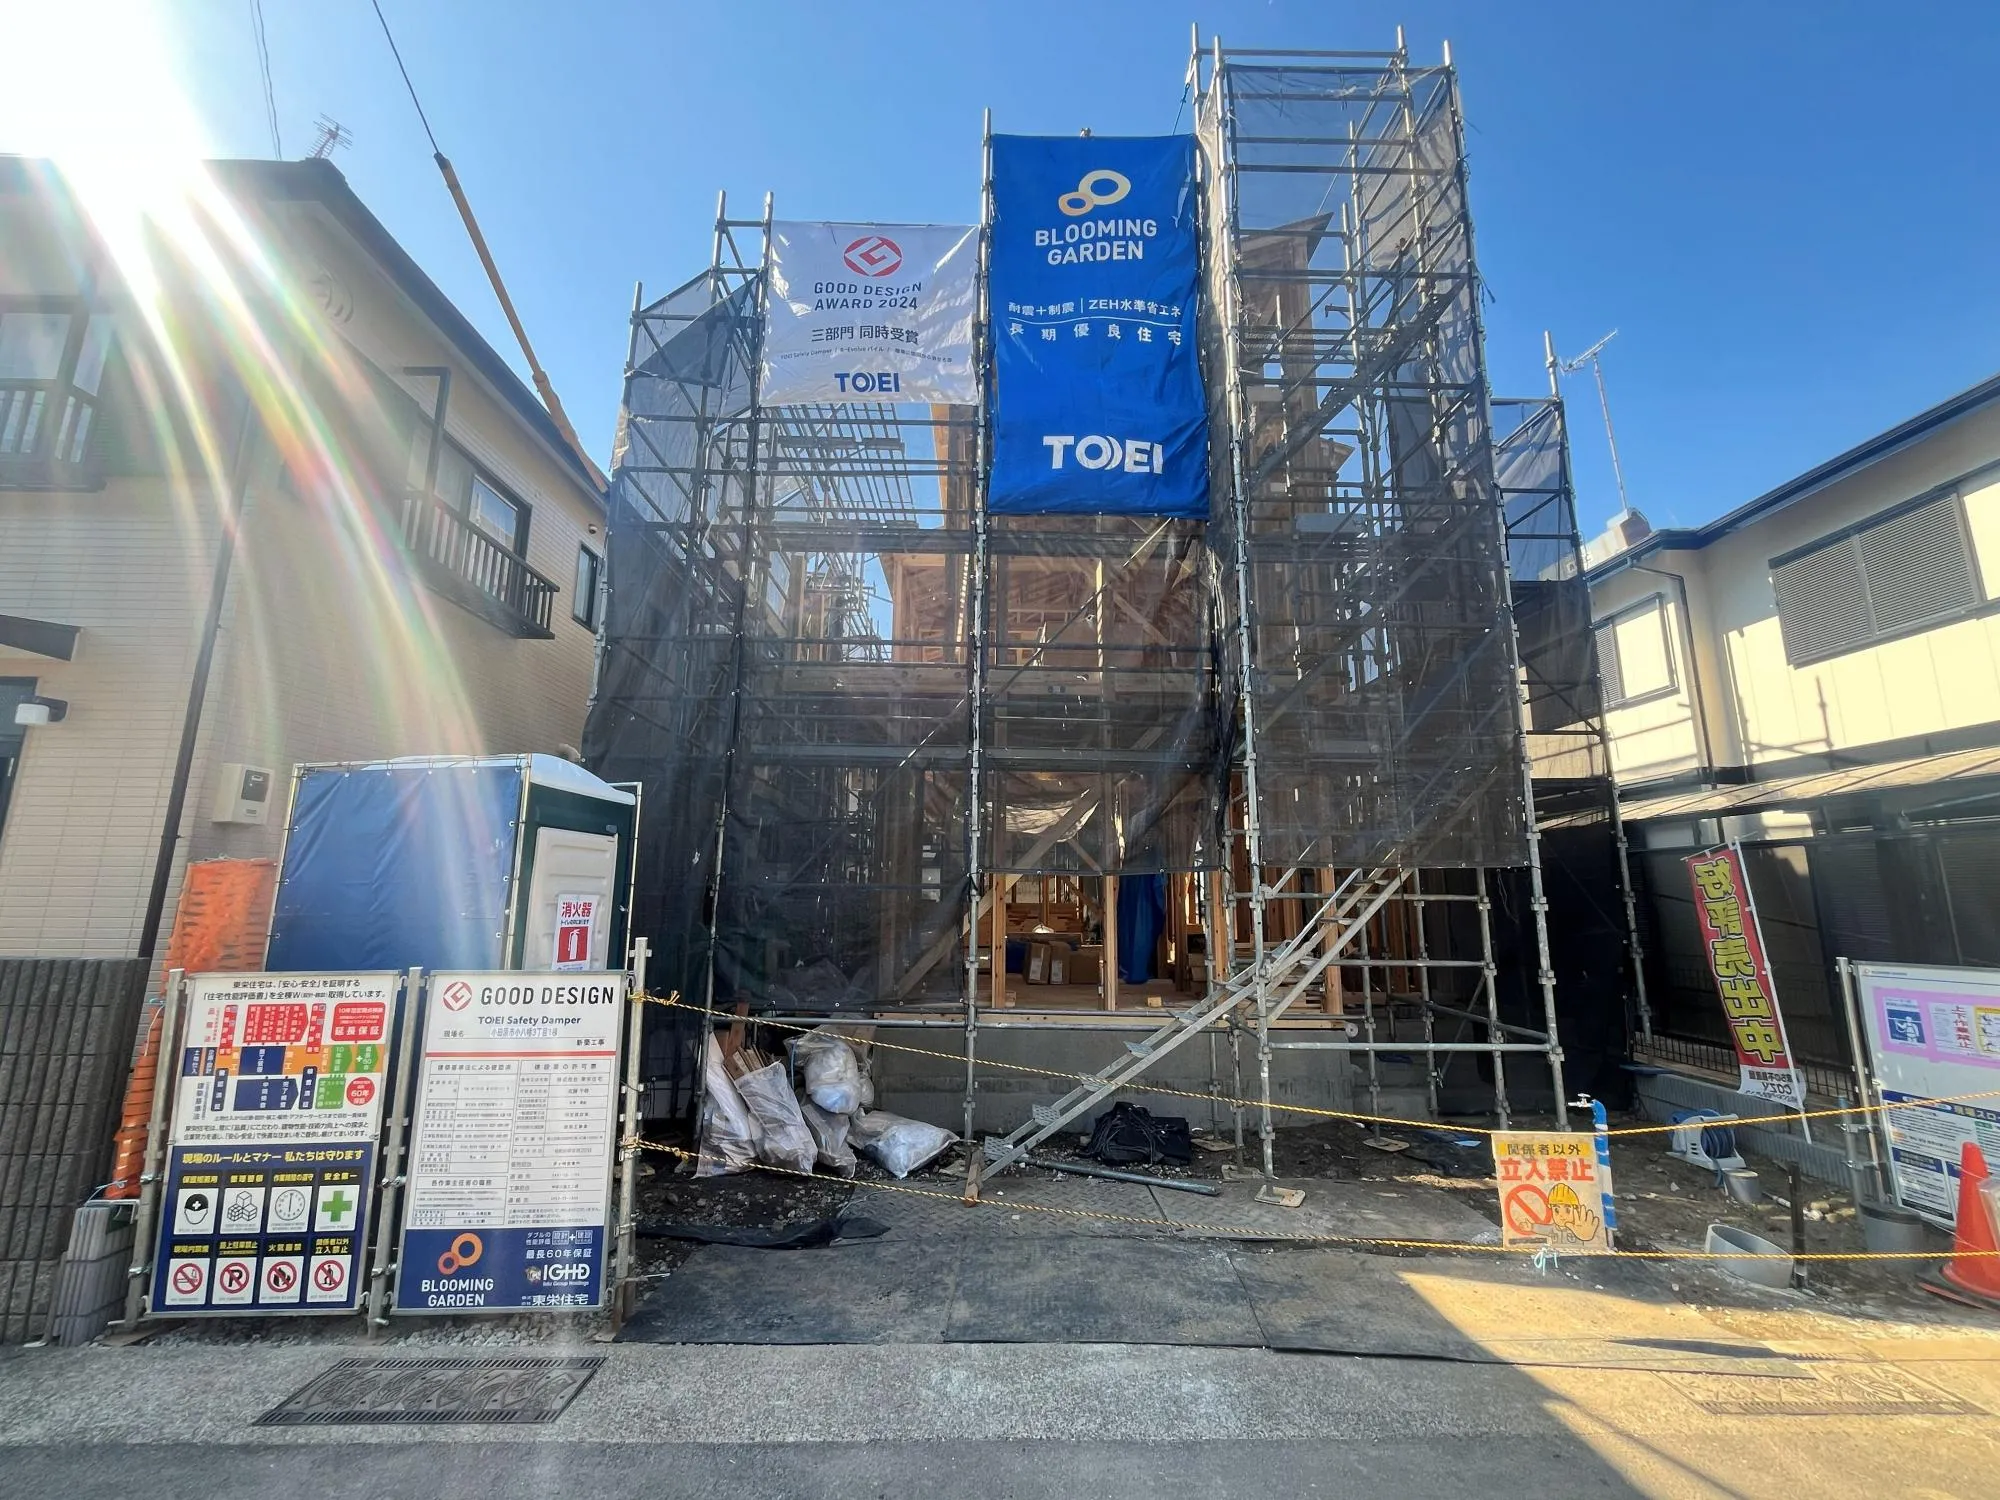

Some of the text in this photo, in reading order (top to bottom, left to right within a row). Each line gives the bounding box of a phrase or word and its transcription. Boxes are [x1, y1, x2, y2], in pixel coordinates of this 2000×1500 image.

[1035, 219, 1157, 246] BLOOMING
[1047, 240, 1143, 266] GARDEN
[814, 281, 922, 296] GOOD DESIGN
[814, 296, 918, 311] AWARD 2024
[811, 325, 920, 345] 三部門 同時受賞
[1009, 322, 1182, 346] 長期優良住宅
[834, 372, 900, 393] TOEI
[1043, 434, 1163, 475] TOEI
[561, 902, 592, 918] 消火器
[481, 986, 614, 1005] GOOD DESIGN
[507, 1016, 538, 1026] Safety
[541, 1015, 581, 1026] Damper
[182, 1149, 365, 1164] 現場のルールとマナー 私たちは守ります
[1507, 1143, 1581, 1155] 関係者以外
[324, 1172, 358, 1181] 安全第一
[1499, 1157, 1595, 1182] 立入禁止
[314, 1246, 348, 1254] 立入禁止
[526, 1248, 593, 1260] 最長60年保証
[421, 1278, 494, 1292] BLOOMING
[427, 1293, 485, 1307] GARDEN
